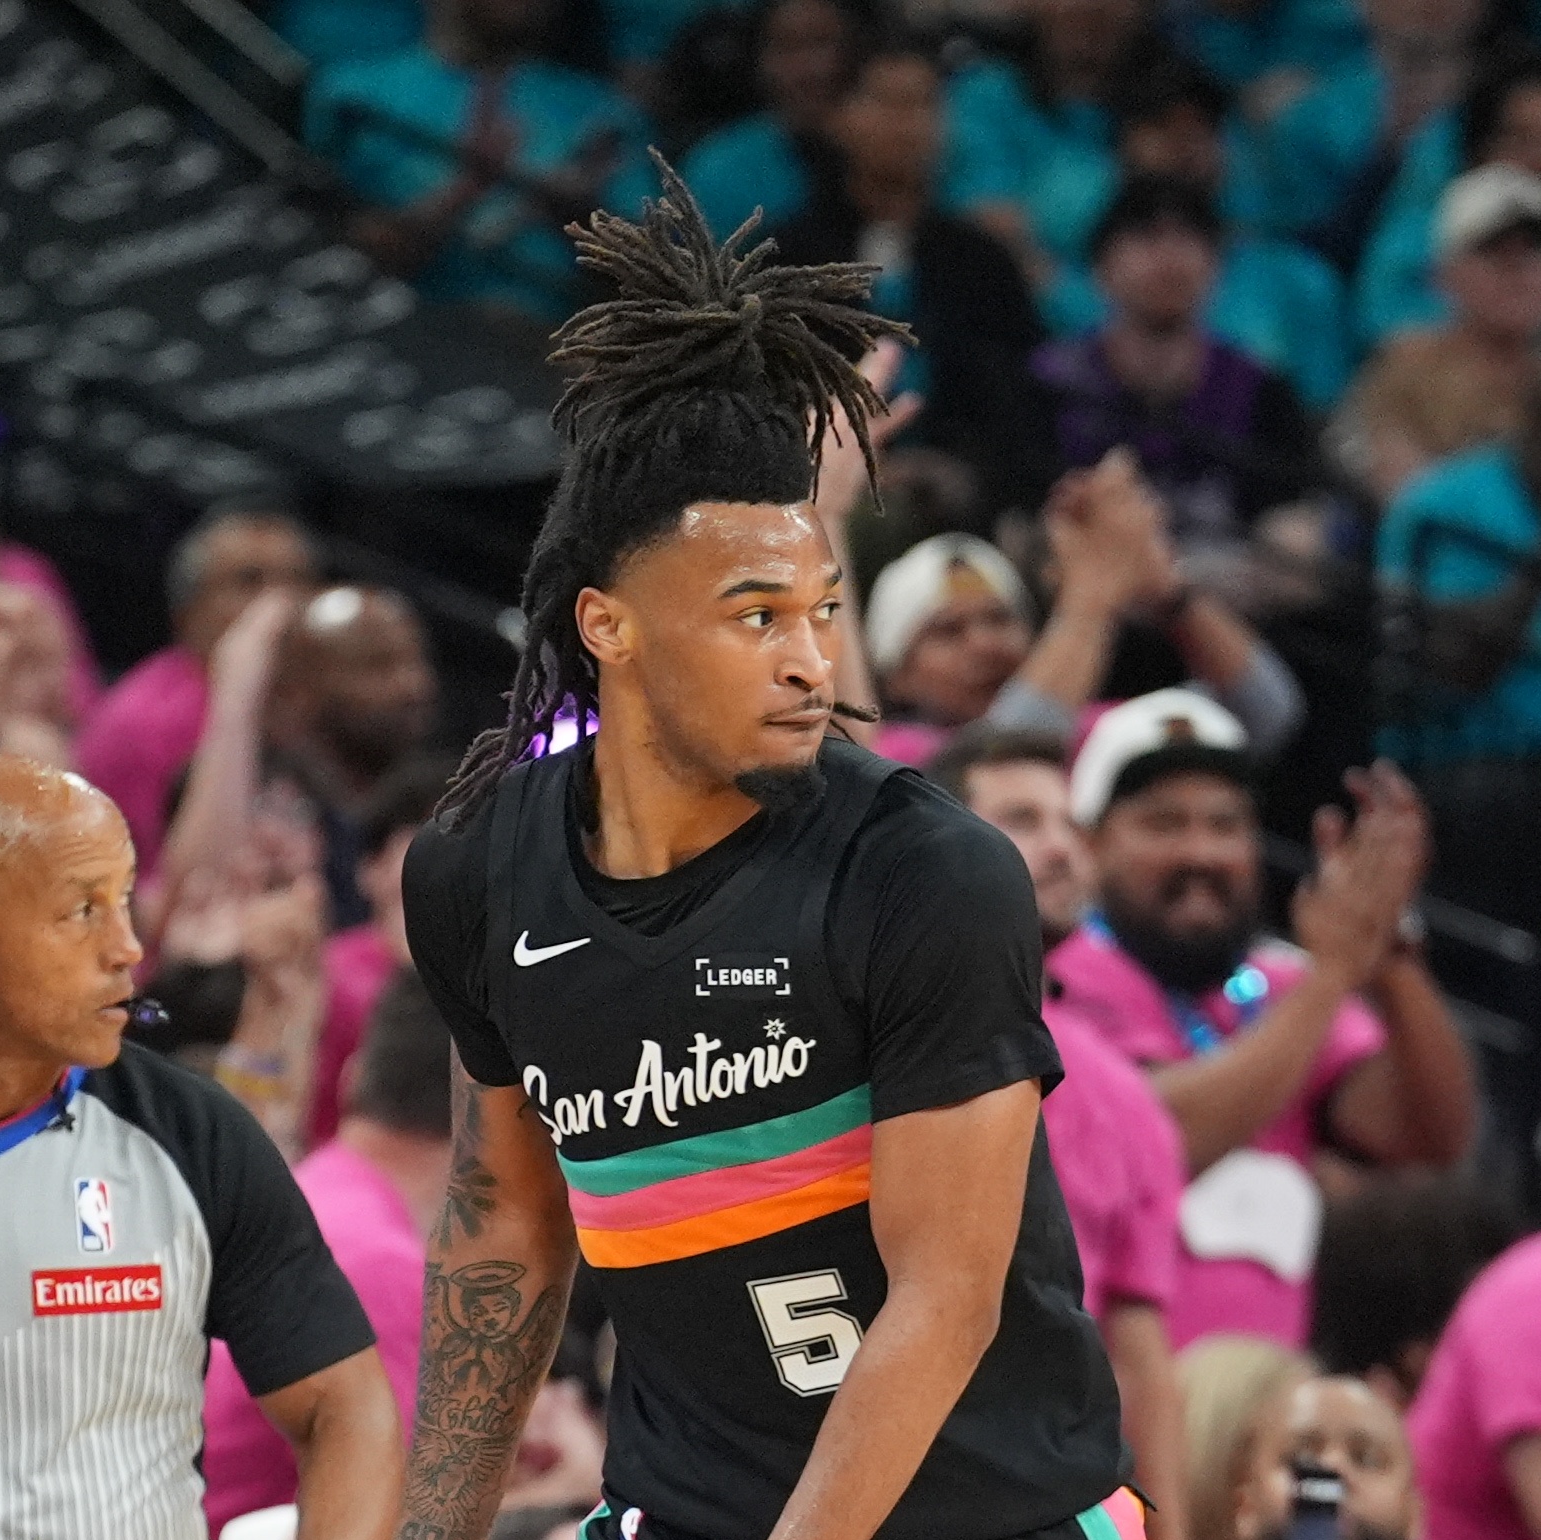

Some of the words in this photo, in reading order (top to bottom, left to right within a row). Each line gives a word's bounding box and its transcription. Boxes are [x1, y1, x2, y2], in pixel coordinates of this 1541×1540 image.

[706, 967, 778, 987] LEDGER
[522, 1064, 607, 1146] San
[614, 1018, 816, 1127] Antonio
[35, 1275, 160, 1308] Emirates
[746, 1268, 863, 1397] 5
